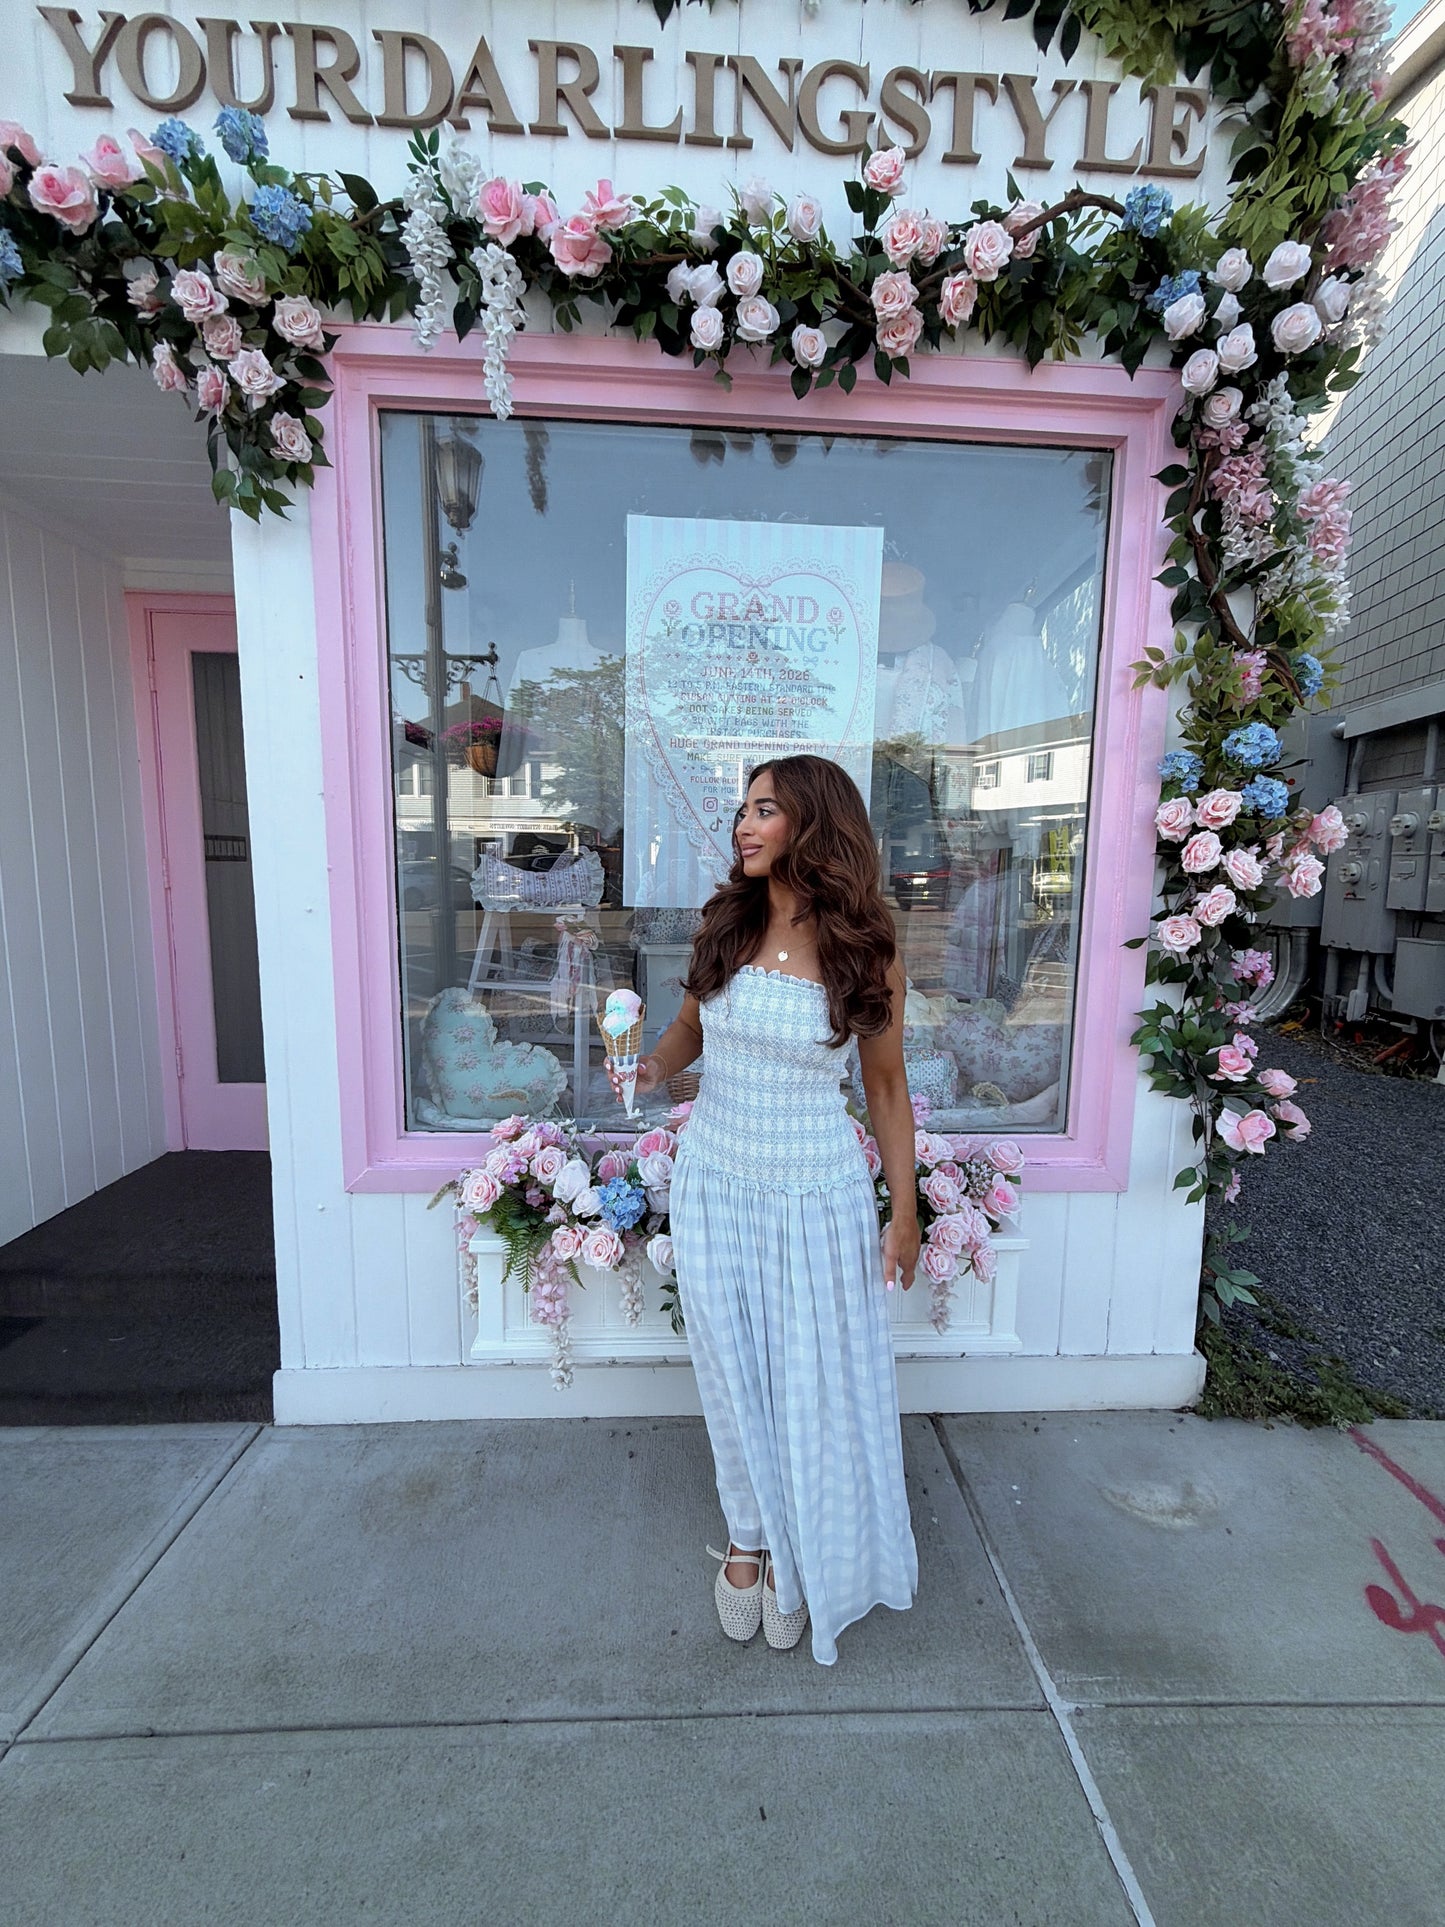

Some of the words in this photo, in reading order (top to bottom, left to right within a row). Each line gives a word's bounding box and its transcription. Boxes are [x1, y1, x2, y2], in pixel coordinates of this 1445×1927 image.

[690, 591, 820, 624] GRAND
[681, 622, 828, 652] OPENING
[700, 666, 736, 678] JUNE
[741, 667, 775, 681] 14TH,
[779, 669, 810, 681] 2026
[681, 680, 693, 689] TO
[726, 682, 766, 692] EASTERN
[769, 683, 814, 693] STANDARD
[761, 695, 773, 704] AT
[791, 696, 828, 706] O'CLOCK
[689, 704, 708, 713] DOT
[745, 706, 774, 716] BEING
[777, 707, 812, 717] SERVED
[734, 717, 758, 727] BAGS
[761, 719, 787, 728] WITH
[792, 719, 809, 729] THE
[700, 727, 728, 736] FIRST
[747, 729, 802, 739] PURCHASES
[670, 738, 698, 749] HUGE
[703, 739, 740, 750] GRAND
[744, 740, 789, 752] OPENING
[687, 752, 712, 761] MAKE
[717, 753, 741, 762] SURE
[690, 775, 720, 784] FOLLOW
[703, 785, 718, 794] FOR
